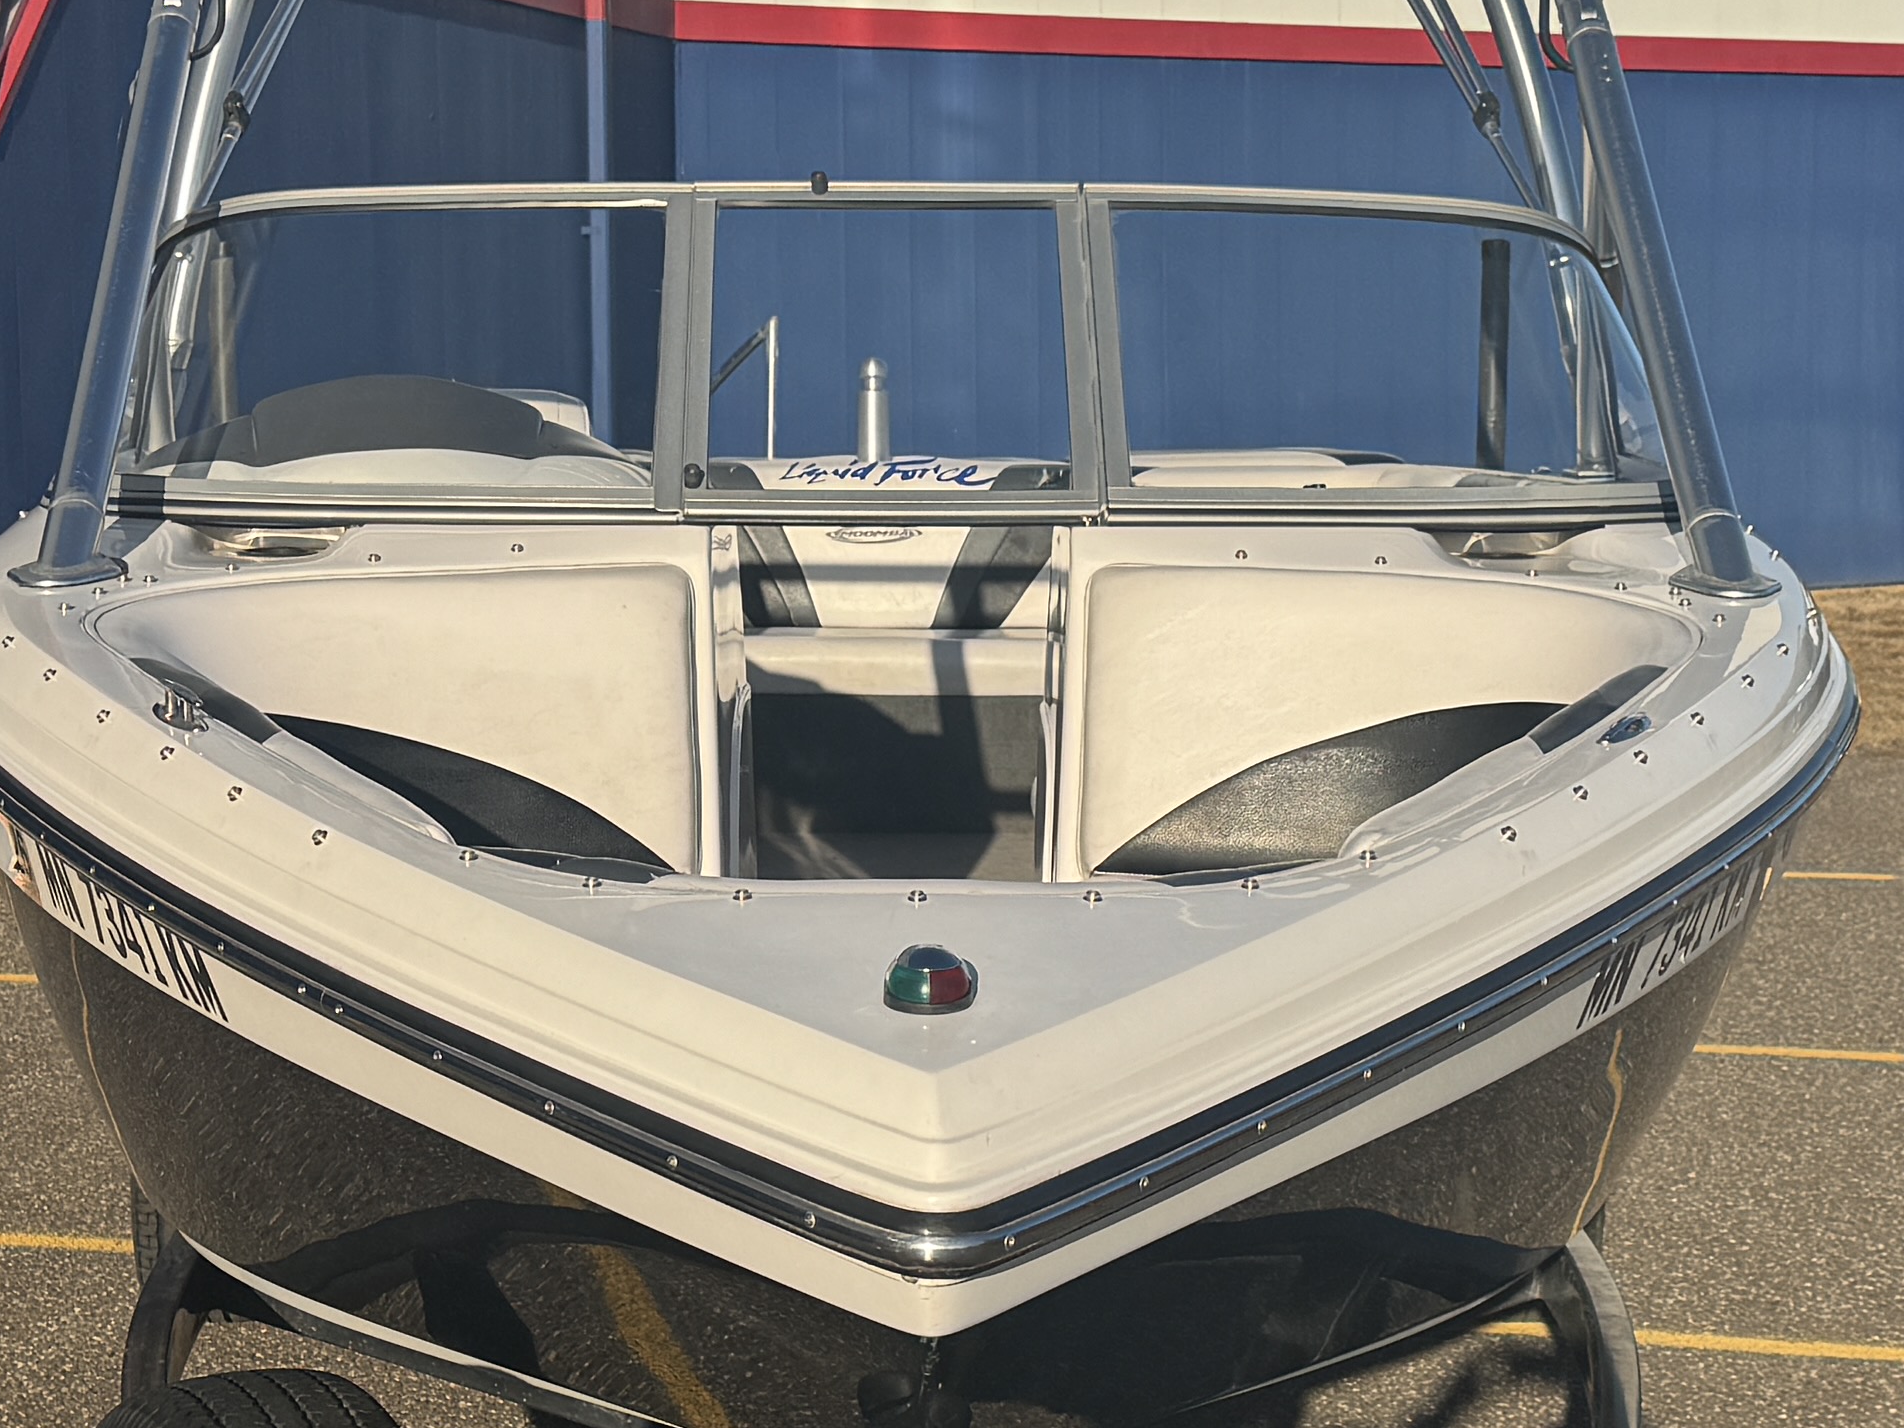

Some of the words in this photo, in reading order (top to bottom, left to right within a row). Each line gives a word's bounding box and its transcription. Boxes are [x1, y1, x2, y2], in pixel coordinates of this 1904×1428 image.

[780, 459, 879, 485] Liquid
[874, 456, 997, 486] Force
[35, 839, 86, 931] MN
[76, 871, 169, 989] 7341
[154, 922, 230, 1024] KM
[1576, 933, 1647, 1030] MN
